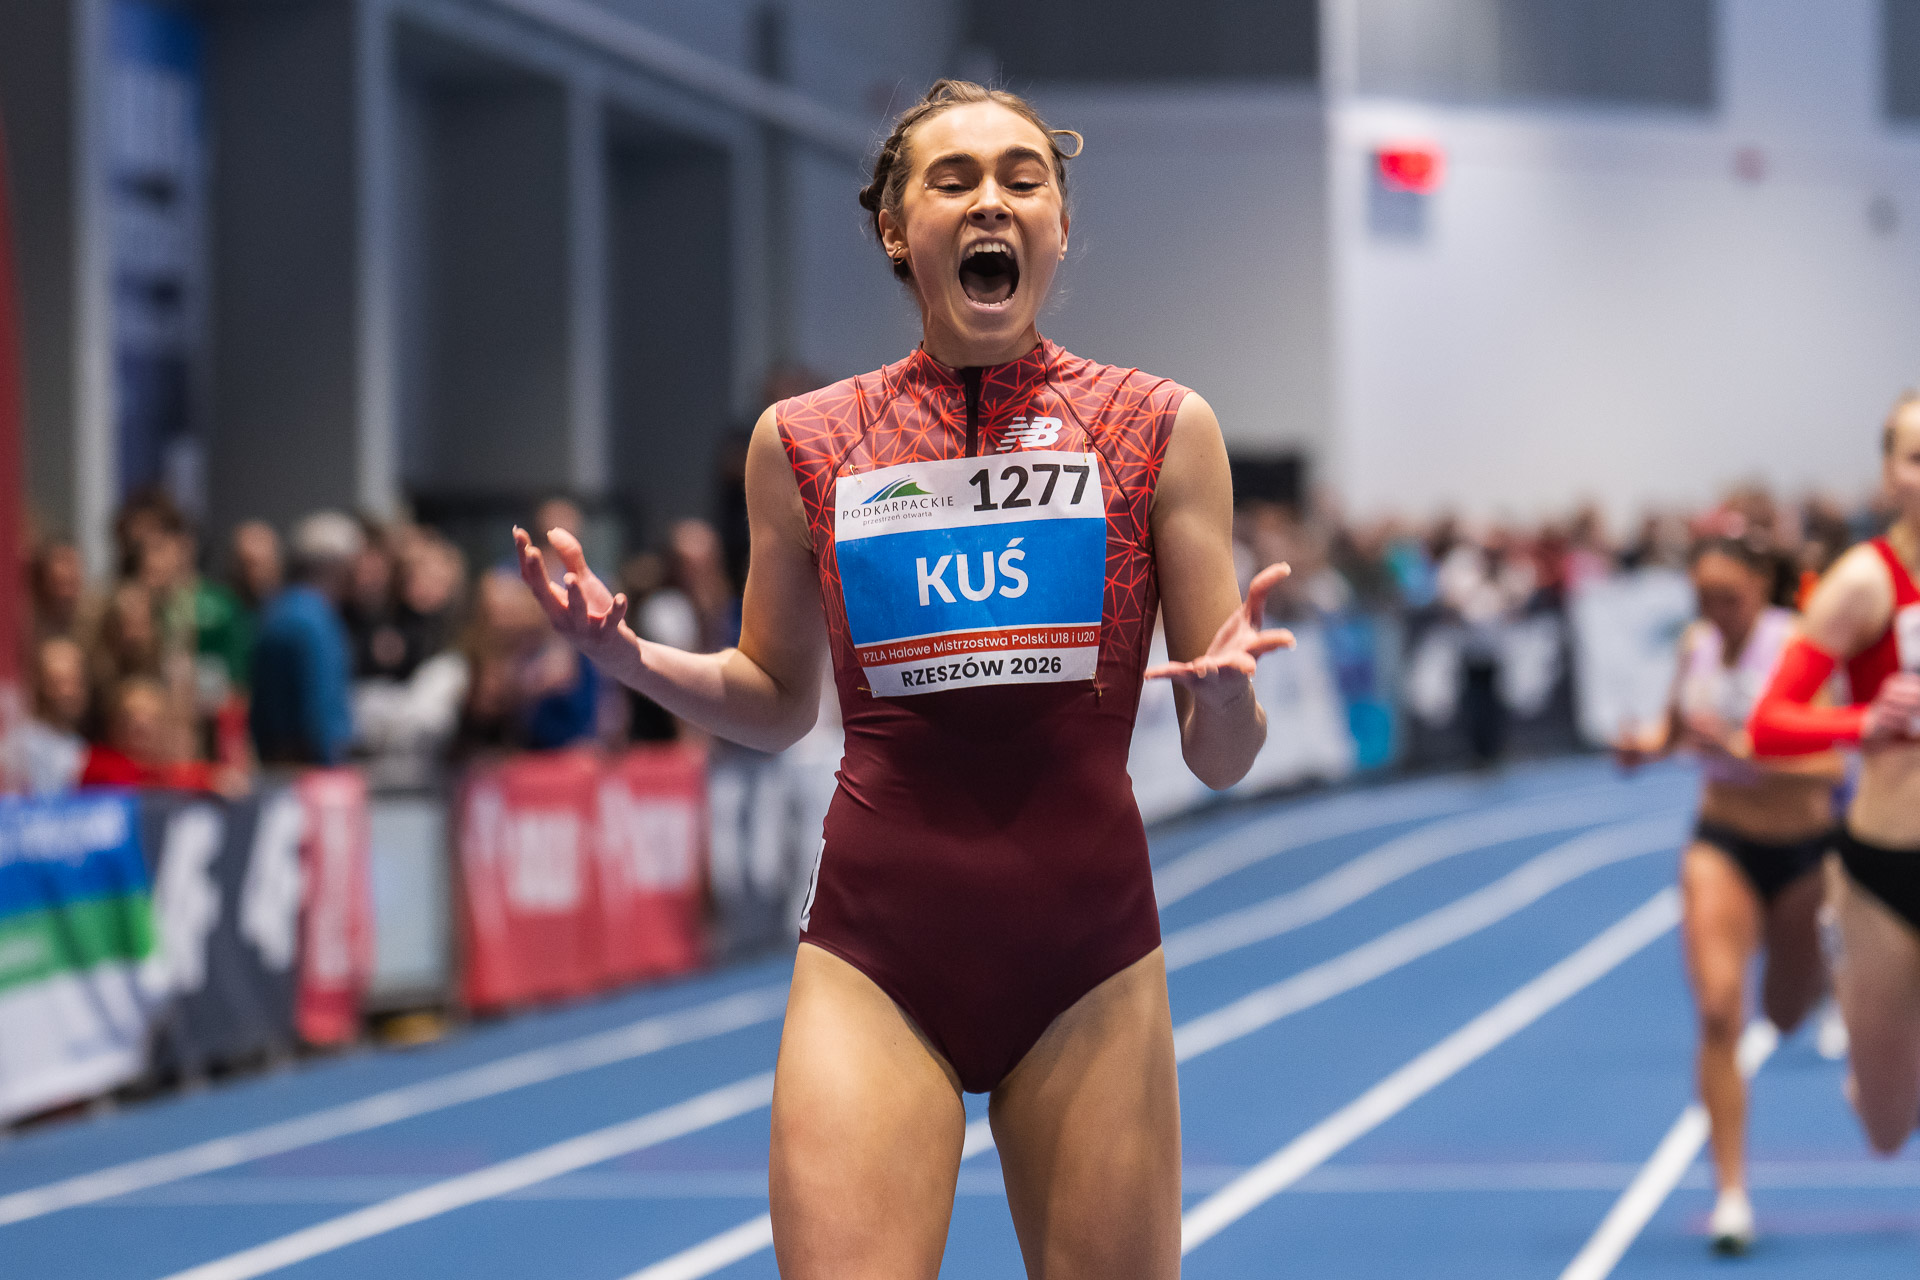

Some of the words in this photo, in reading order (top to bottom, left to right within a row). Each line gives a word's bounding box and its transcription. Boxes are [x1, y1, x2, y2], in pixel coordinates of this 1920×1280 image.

[968, 463, 1090, 512] 1277
[842, 495, 955, 520] PODKARPACKIE
[862, 513, 901, 526] przestrzeń
[903, 510, 933, 520] otwarta
[915, 537, 1029, 607] KUŚ
[863, 650, 888, 663] PZLA
[889, 646, 931, 660] Halowe
[933, 636, 1008, 653] Mistrzostwa
[1011, 632, 1048, 646] Polski
[1050, 631, 1070, 644] U18
[1071, 631, 1076, 643] i
[1077, 631, 1096, 643] U20
[901, 656, 1004, 687] RZESZÓW
[1010, 656, 1062, 675] 2026
